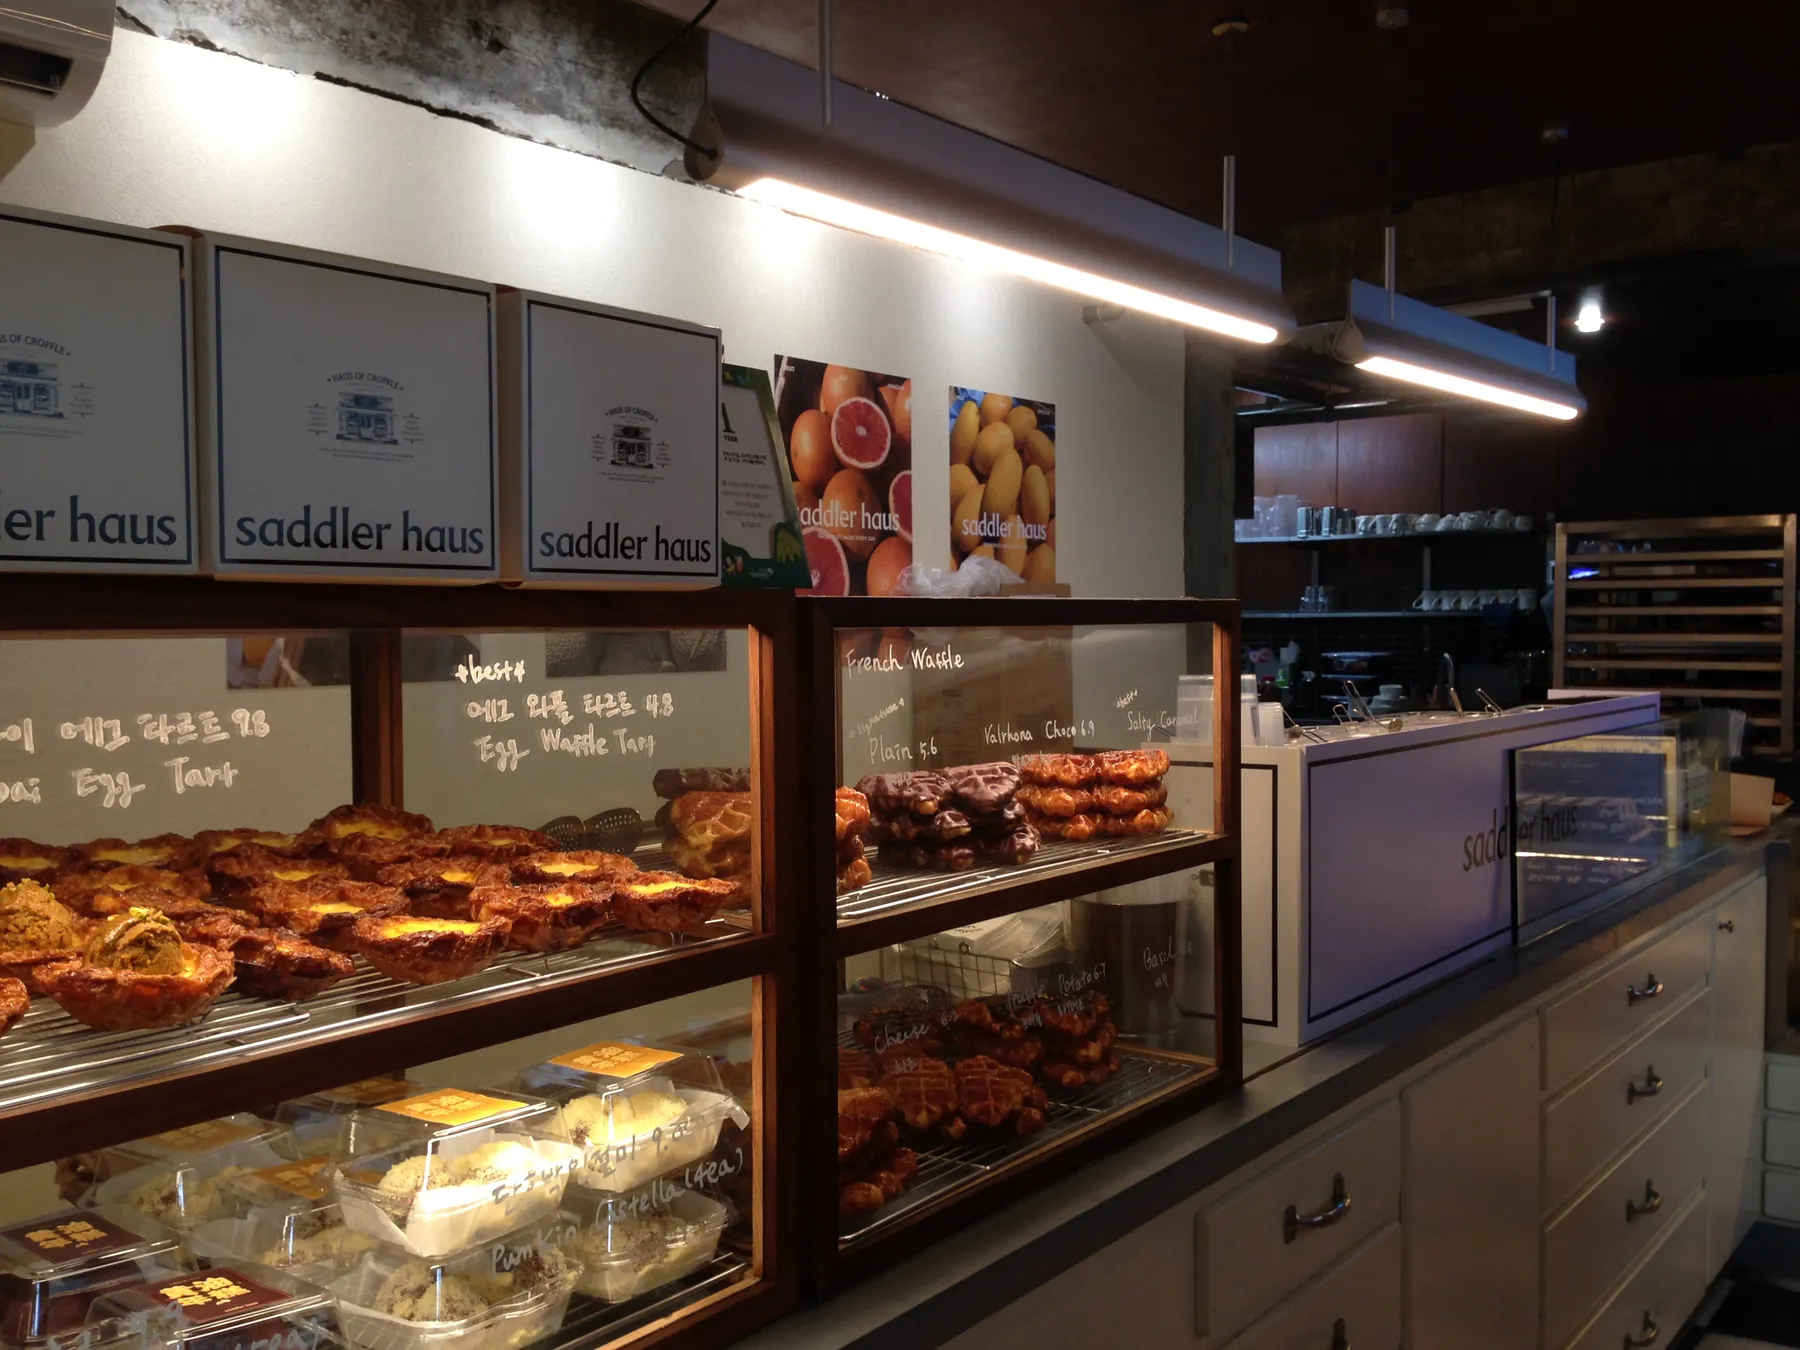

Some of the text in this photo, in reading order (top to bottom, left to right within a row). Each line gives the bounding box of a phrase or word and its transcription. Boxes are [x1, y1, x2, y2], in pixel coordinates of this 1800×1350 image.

[69, 494, 178, 546] haus
[235, 504, 485, 555] saddler haus
[798, 498, 857, 528] addler
[860, 502, 901, 531] haus
[961, 511, 1048, 541] saddler haus
[538, 520, 712, 564] saddler haus
[845, 644, 965, 680] French Waffle
[466, 698, 515, 723] 에그
[526, 689, 575, 725] 와플
[582, 690, 637, 717] 타르트
[60, 716, 131, 752] 에그
[137, 710, 231, 745] 타르트
[1045, 719, 1077, 740] Choco
[1127, 710, 1156, 742] Salty
[474, 723, 656, 772] Egg Waffle Tart
[869, 734, 939, 765] Plain 5.6
[71, 768, 146, 808] Egg
[164, 757, 239, 793] Tart
[1462, 799, 1579, 872] sadder haus
[1142, 936, 1177, 971] Basil
[1057, 969, 1092, 996] Potato
[874, 1021, 931, 1054] Cheese
[491, 1225, 578, 1279] Pumkin
